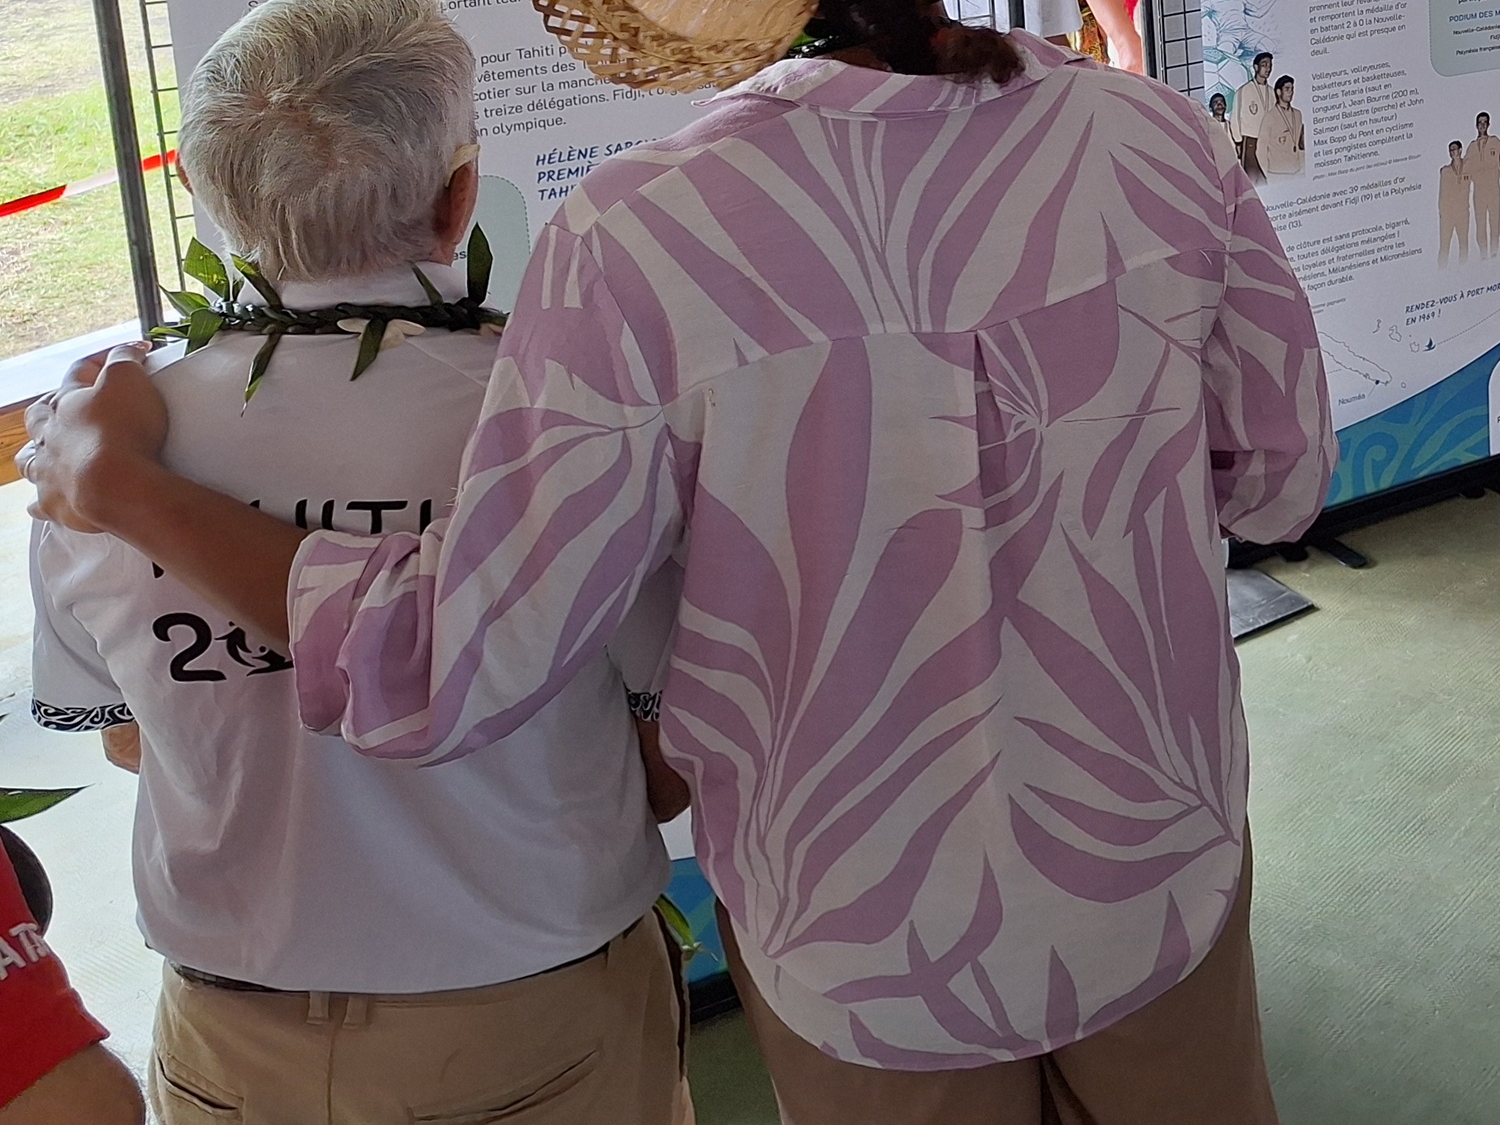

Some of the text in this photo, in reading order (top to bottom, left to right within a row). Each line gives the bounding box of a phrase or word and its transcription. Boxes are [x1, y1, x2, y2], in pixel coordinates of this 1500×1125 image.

[1449, 13, 1477, 22] PODIUM
[480, 45, 554, 67] pour Tahiti
[477, 60, 576, 82] vêtements des
[515, 85, 536, 96] sur
[541, 81, 554, 93] la
[484, 104, 523, 118] treize
[527, 91, 610, 112] délégations.
[492, 115, 567, 136] olympique.
[536, 145, 599, 166] HÉLÈNE
[1405, 294, 1458, 314] RENDEZ-VOUS
[1459, 290, 1464, 300] À
[1466, 287, 1485, 298] PORT
[1406, 313, 1435, 326] EN 1969
[1338, 393, 1365, 406] Nouméa
